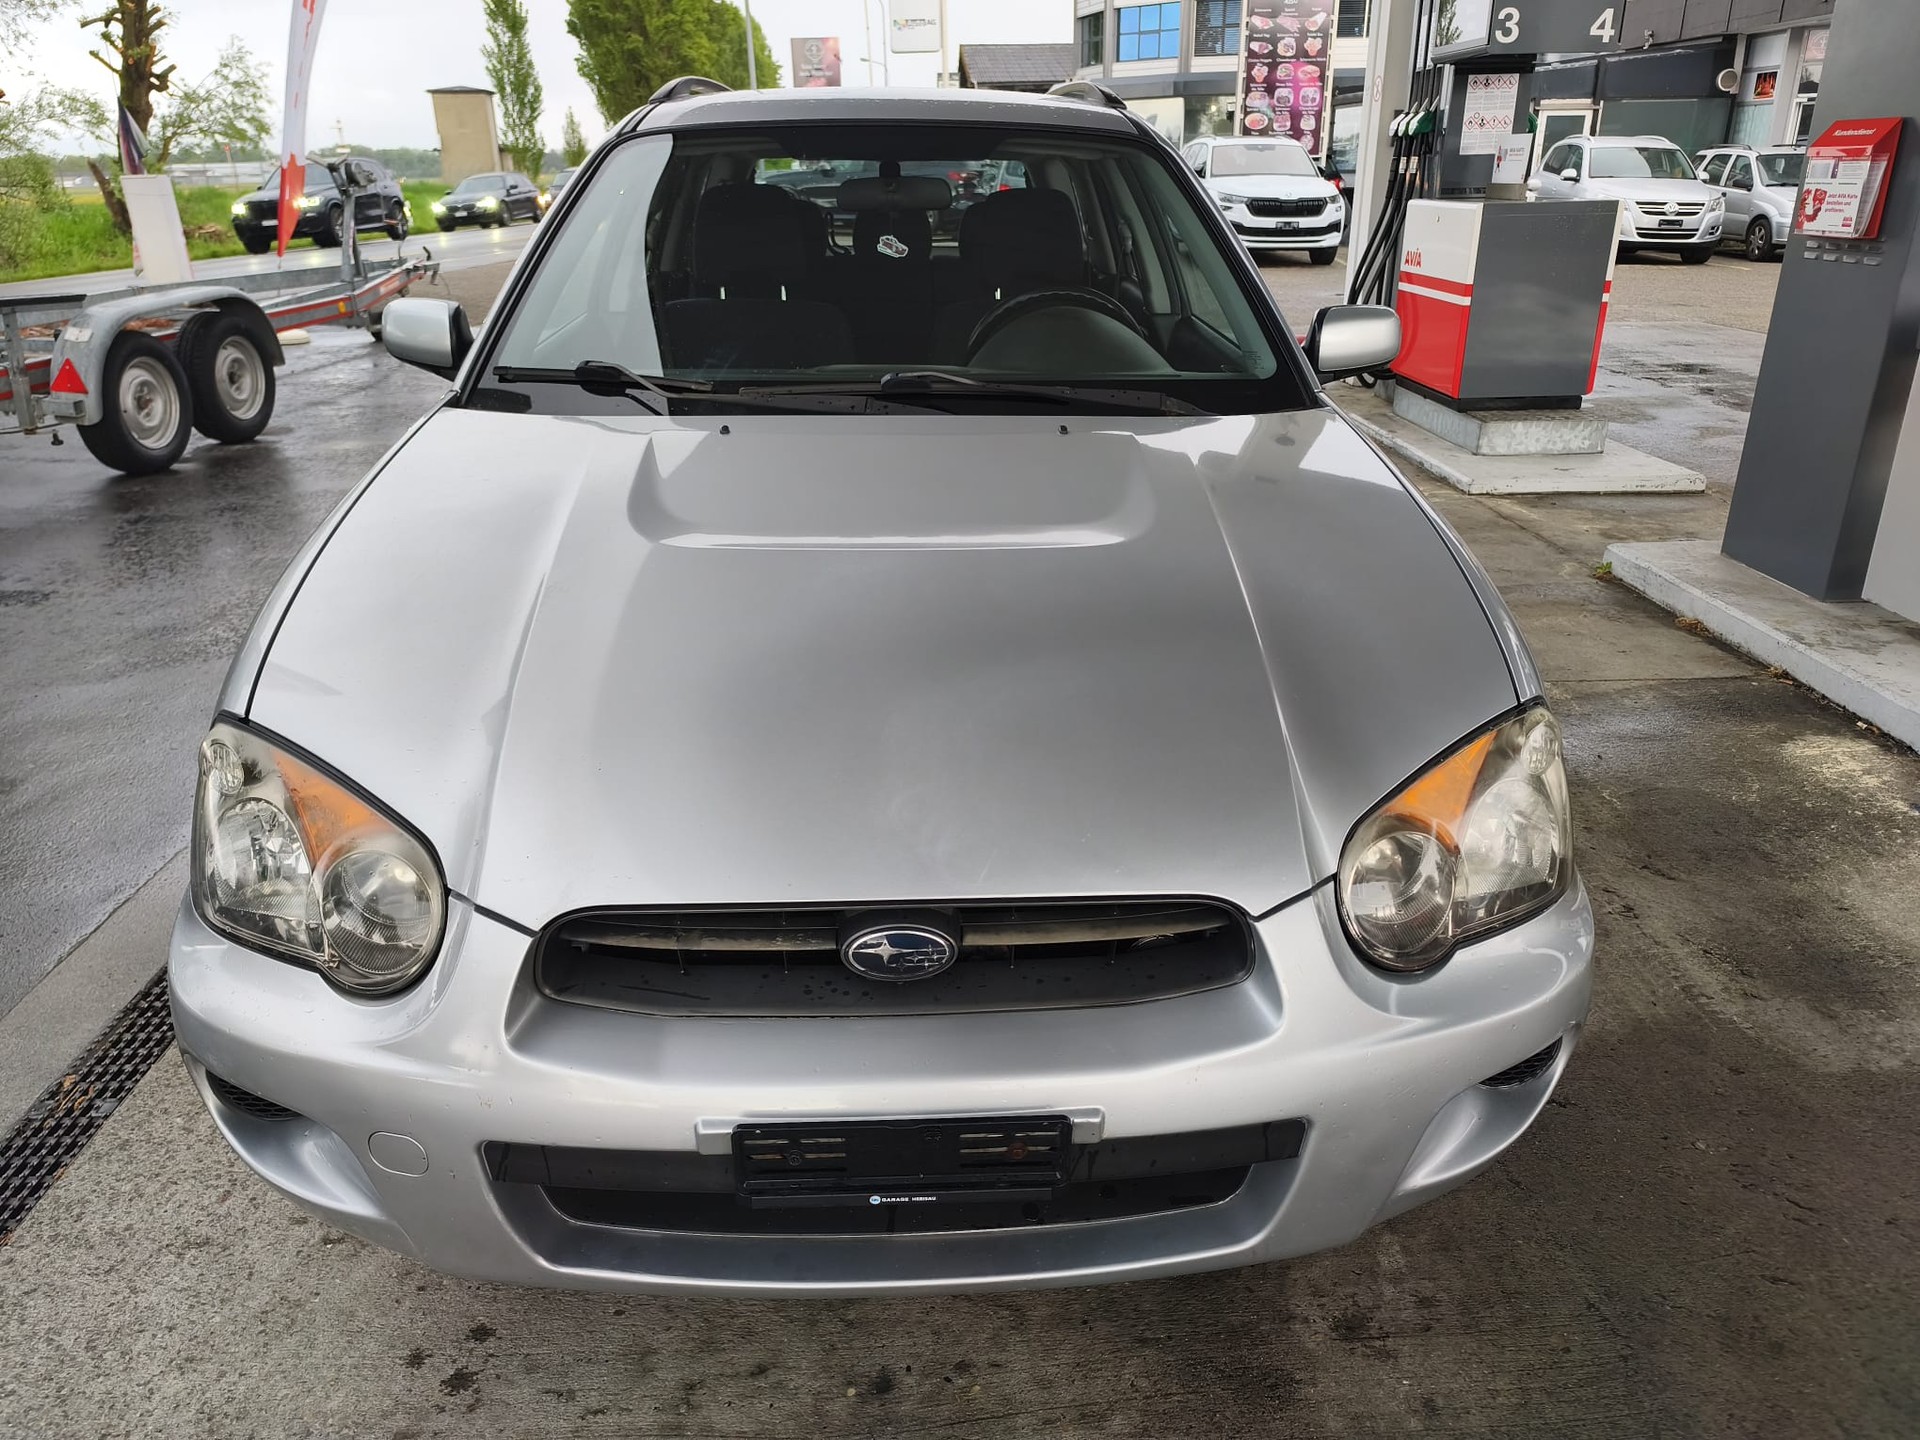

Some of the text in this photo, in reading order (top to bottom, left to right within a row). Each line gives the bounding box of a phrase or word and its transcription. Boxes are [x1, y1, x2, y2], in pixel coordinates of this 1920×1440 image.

[1495, 7, 1520, 44] 3
[1589, 8, 1615, 43] 4
[1832, 128, 1876, 136] Kundendienst
[1404, 248, 1422, 268] AVIA
